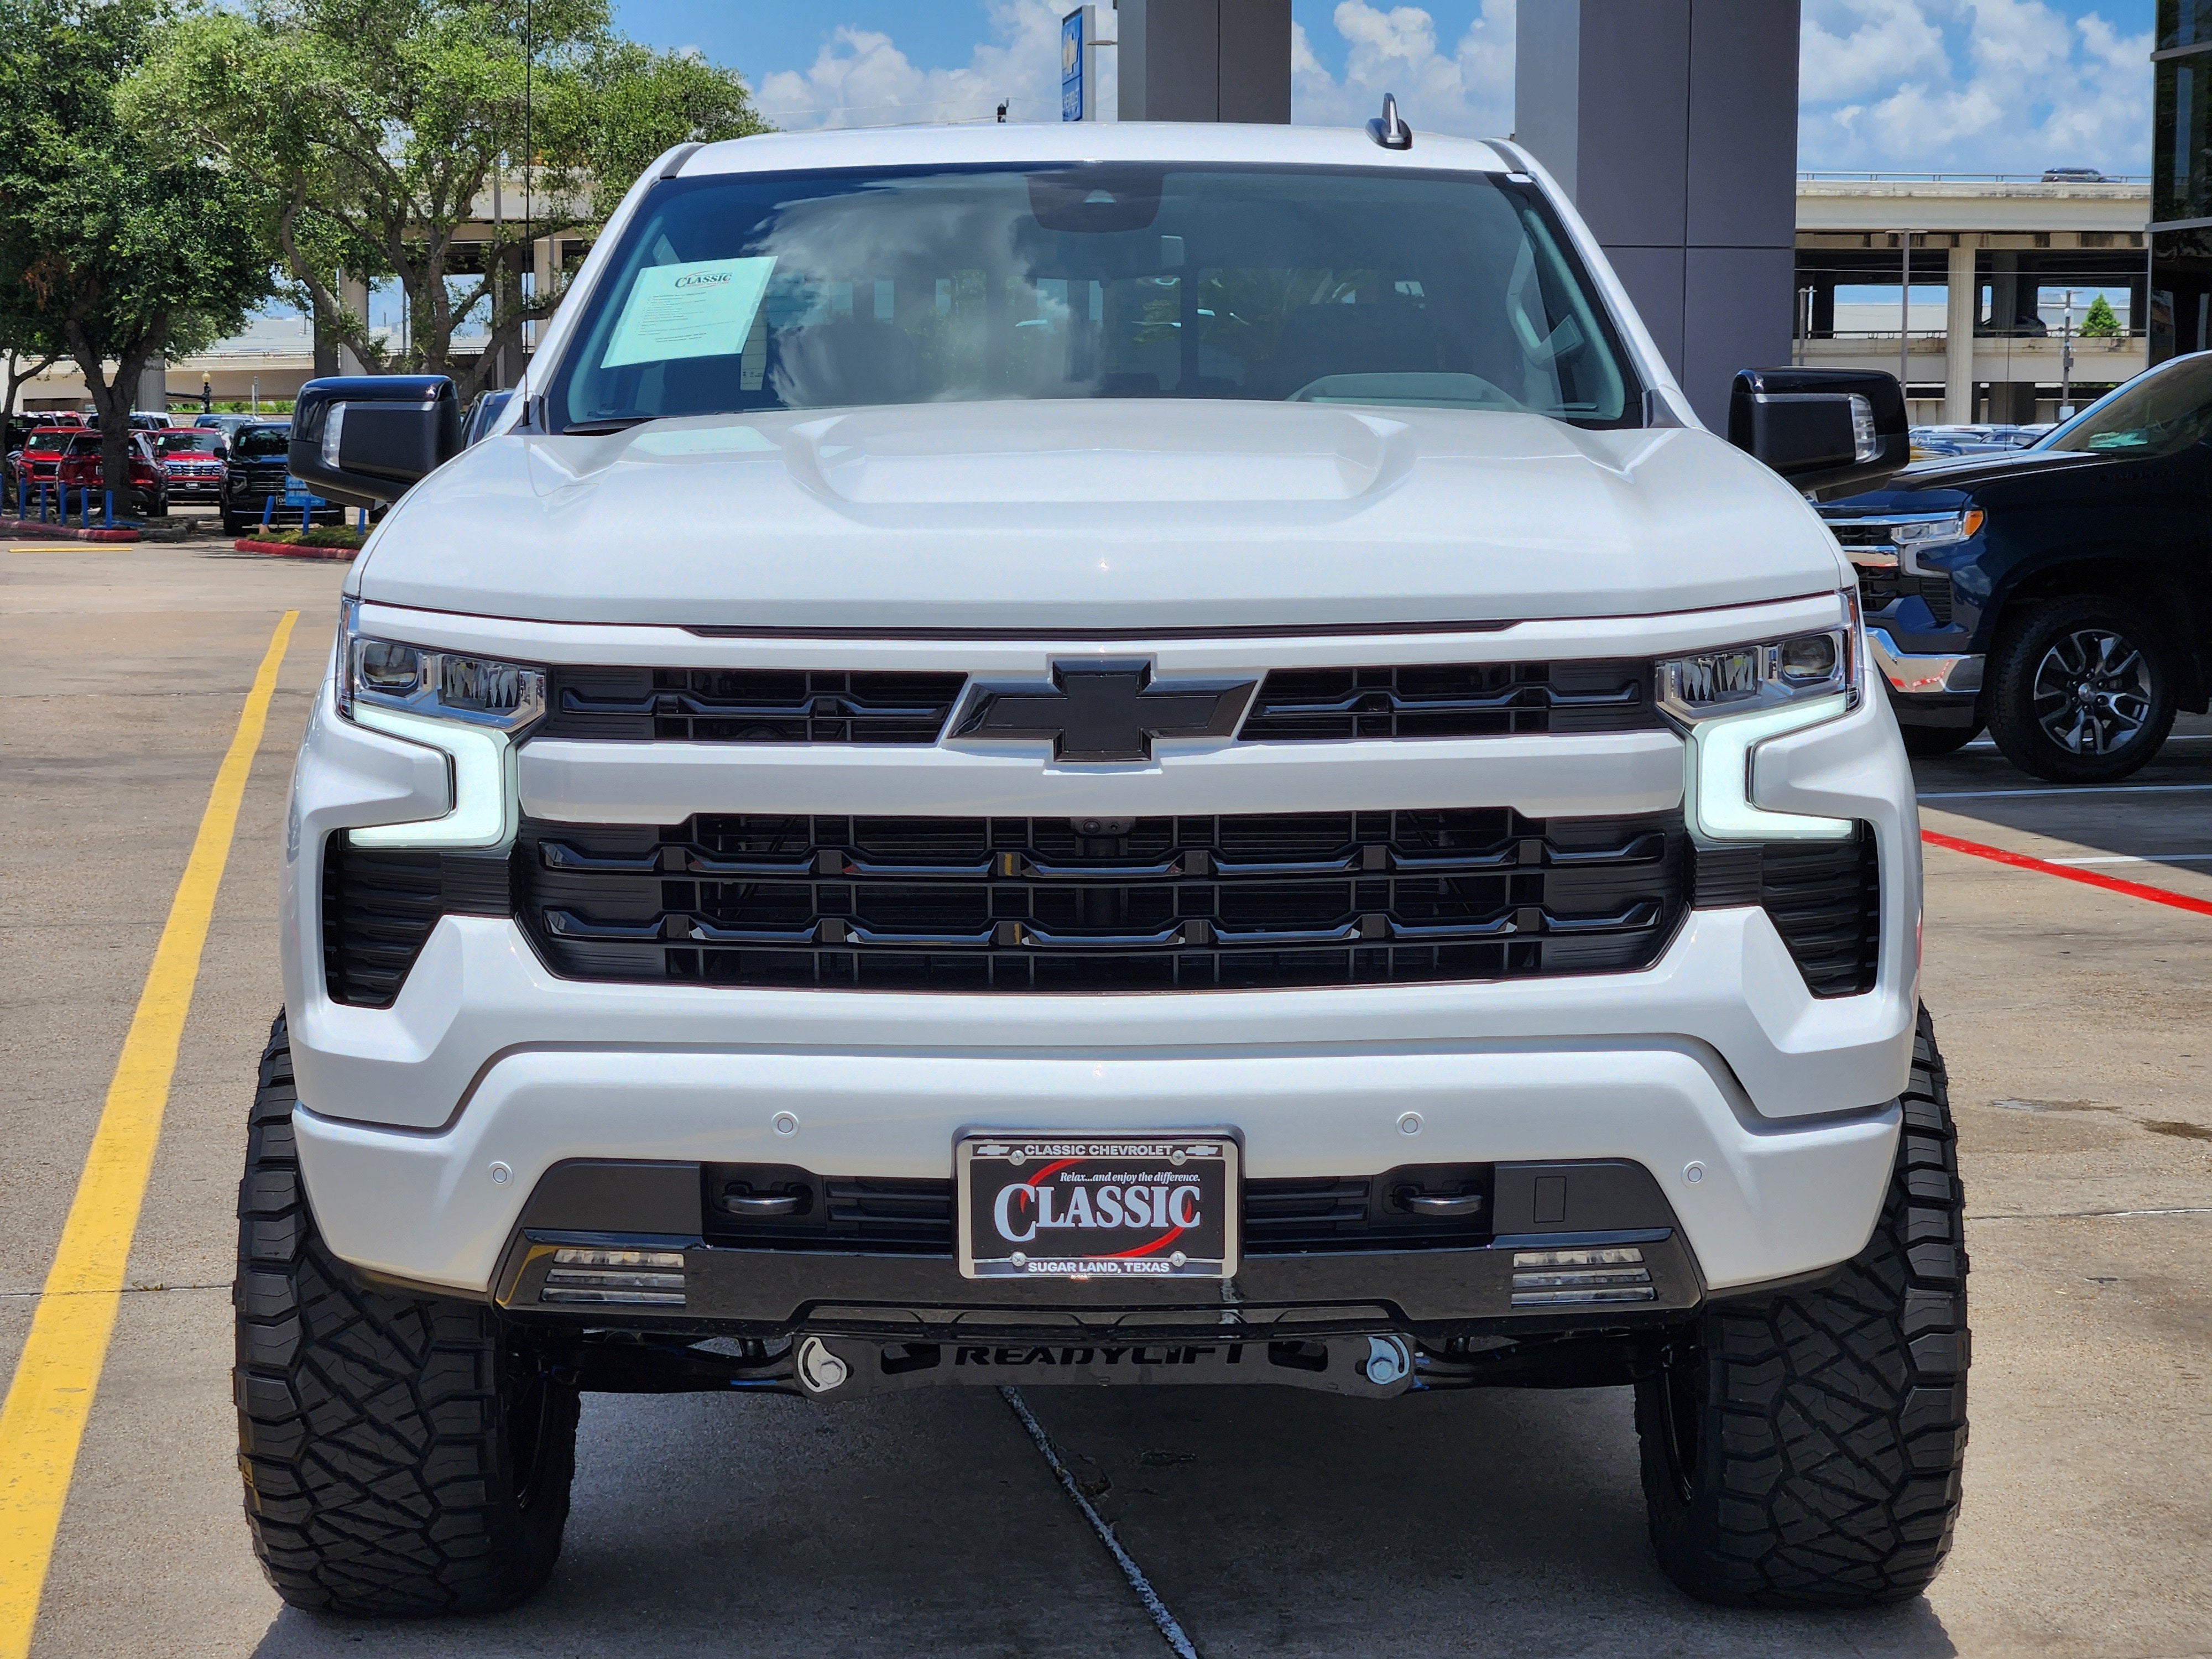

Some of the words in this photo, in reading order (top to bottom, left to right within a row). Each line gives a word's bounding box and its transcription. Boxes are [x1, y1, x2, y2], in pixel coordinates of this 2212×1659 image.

[675, 274, 732, 288] CLASSIC
[1024, 1145, 1086, 1155] CLASSIC
[1088, 1145, 1173, 1156] CHEVROLET
[1112, 1171, 1138, 1185] enjoy
[1138, 1171, 1153, 1182] the
[1154, 1171, 1201, 1185] difference.
[994, 1183, 1201, 1242] CLASSIC
[1027, 1262, 1077, 1272] SUGAR
[1078, 1262, 1121, 1274] LAND,
[1124, 1262, 1170, 1272] TEXAS
[955, 1343, 1243, 1365] READYLIFT
